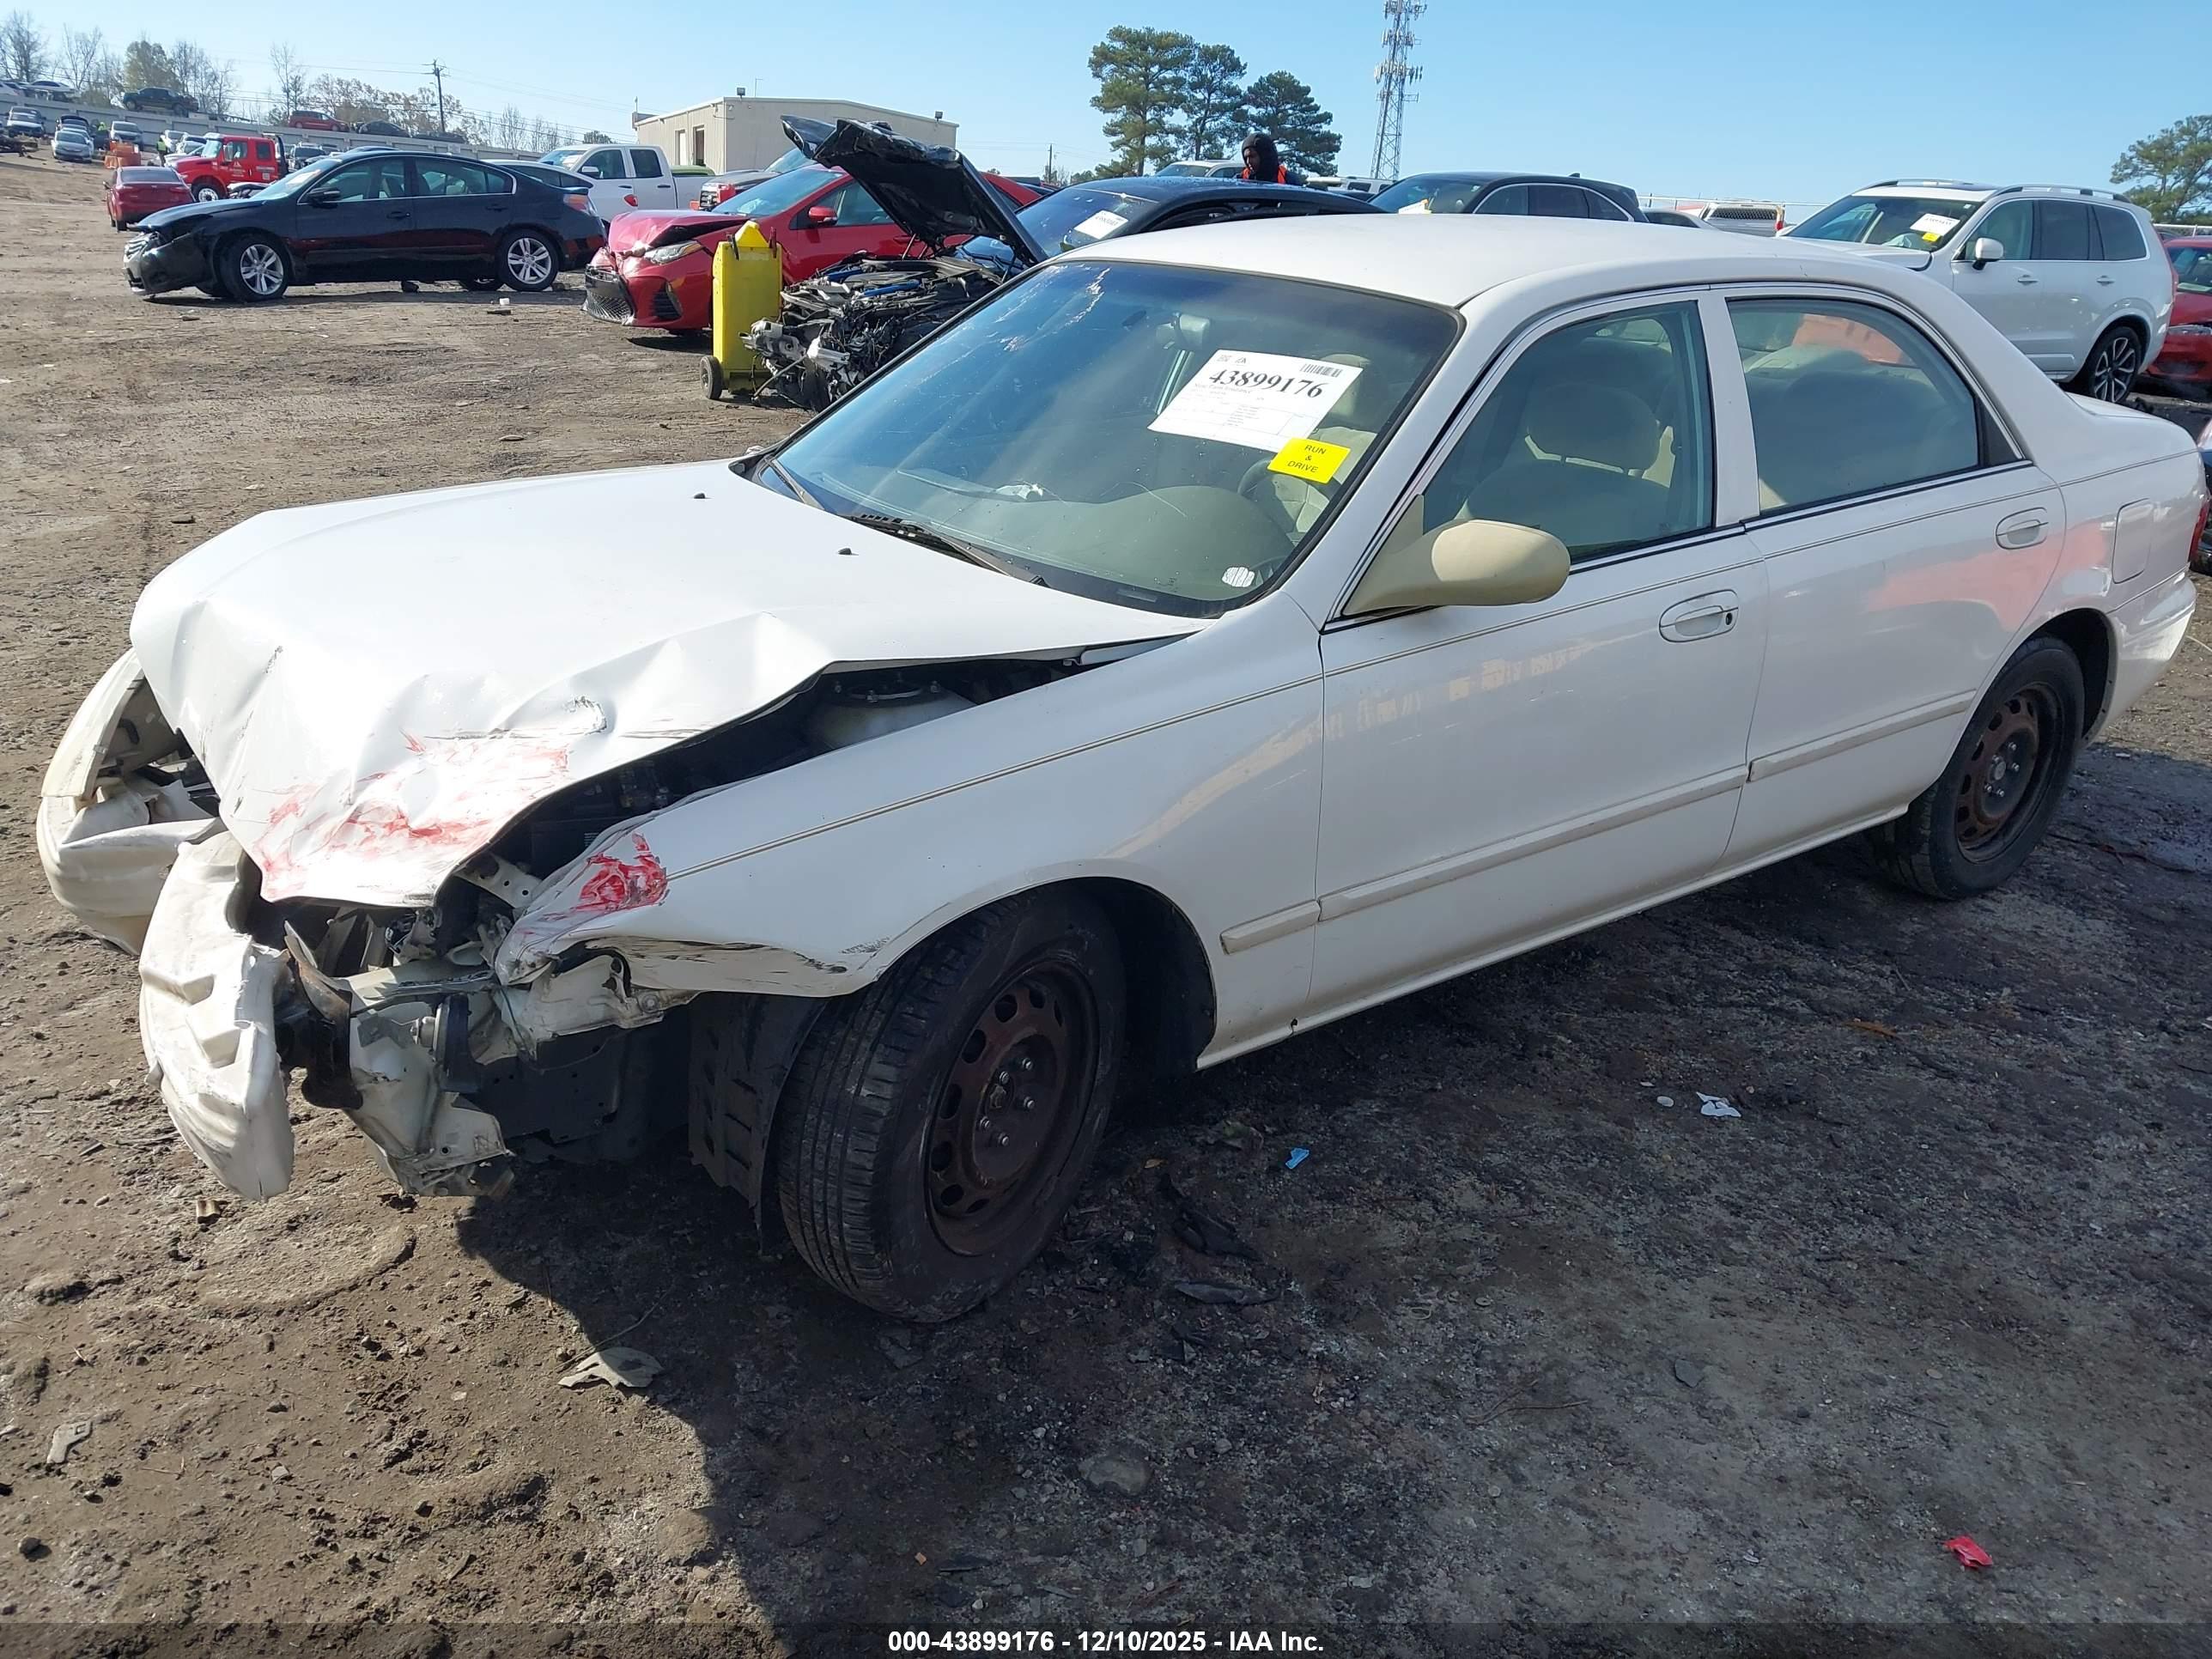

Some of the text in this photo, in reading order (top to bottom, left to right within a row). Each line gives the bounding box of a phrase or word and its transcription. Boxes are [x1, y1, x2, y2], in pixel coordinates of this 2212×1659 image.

[1209, 369, 1328, 398] 43899176
[1304, 445, 1326, 454] RUN
[1287, 460, 1318, 472] DRIVE
